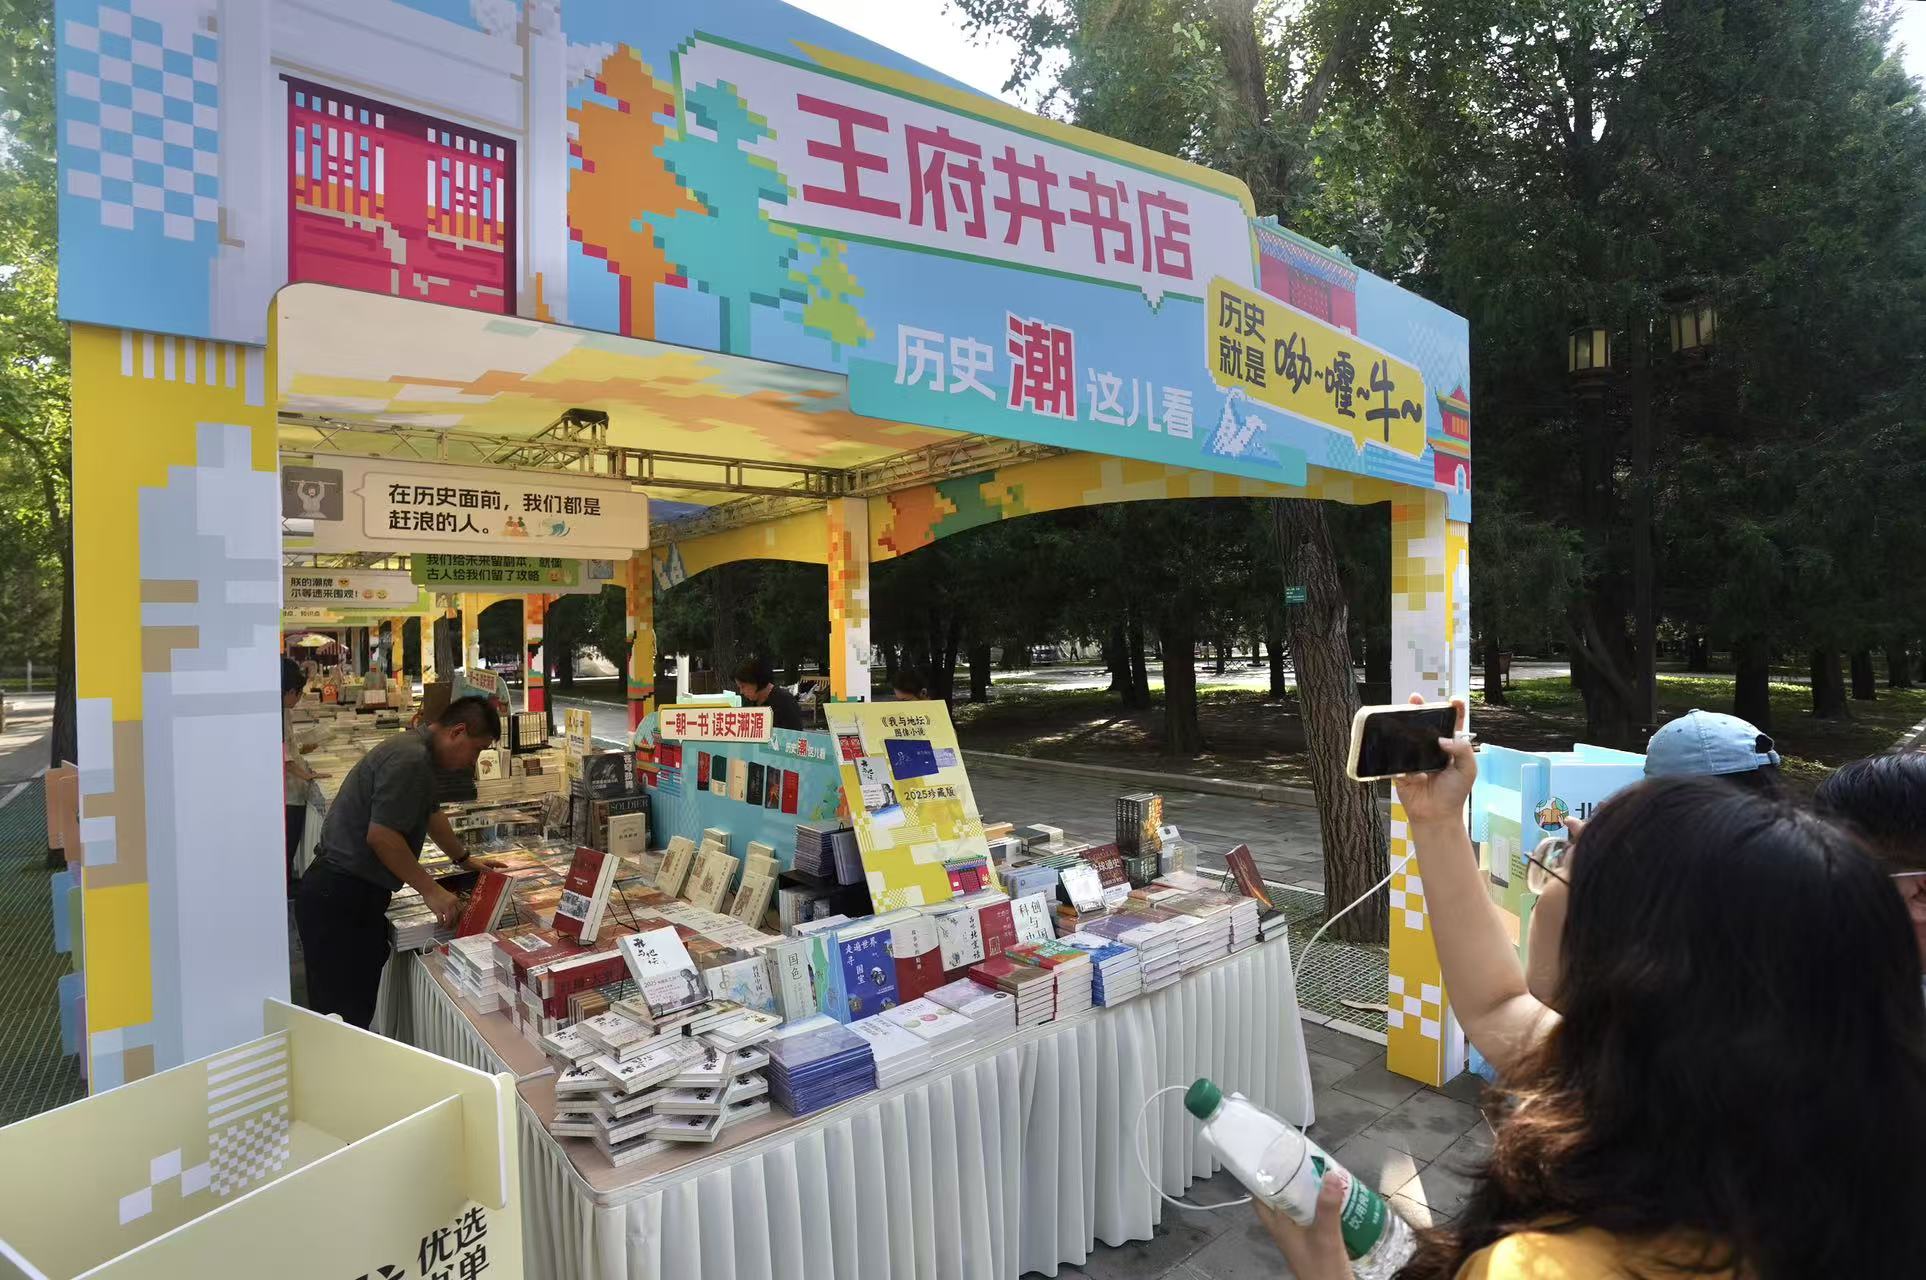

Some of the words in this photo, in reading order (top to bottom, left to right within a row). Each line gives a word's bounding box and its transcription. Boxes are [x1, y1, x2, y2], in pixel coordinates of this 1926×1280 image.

[796, 93, 1194, 281] 王府井书店
[1219, 290, 1266, 344] 历史
[1219, 335, 1267, 389] 就是
[894, 311, 1194, 440] 历史潮这儿看
[388, 483, 601, 516] 在历史面前，我们都是
[388, 510, 490, 535] 赶浪的人。
[426, 568, 540, 582] 古人给我们留了攻略
[665, 713, 709, 736] 一朝一书
[711, 711, 764, 739] 读史溯源
[881, 715, 931, 728] 《我与地坛》
[894, 727, 926, 738] 图像小说
[610, 798, 649, 813] SOLDIER
[903, 786, 956, 801] 2025珍藏版
[1019, 900, 1042, 917] 科创
[845, 936, 878, 954] 走遍世界
[788, 952, 802, 980] 国色
[416, 1206, 488, 1277] 优选
